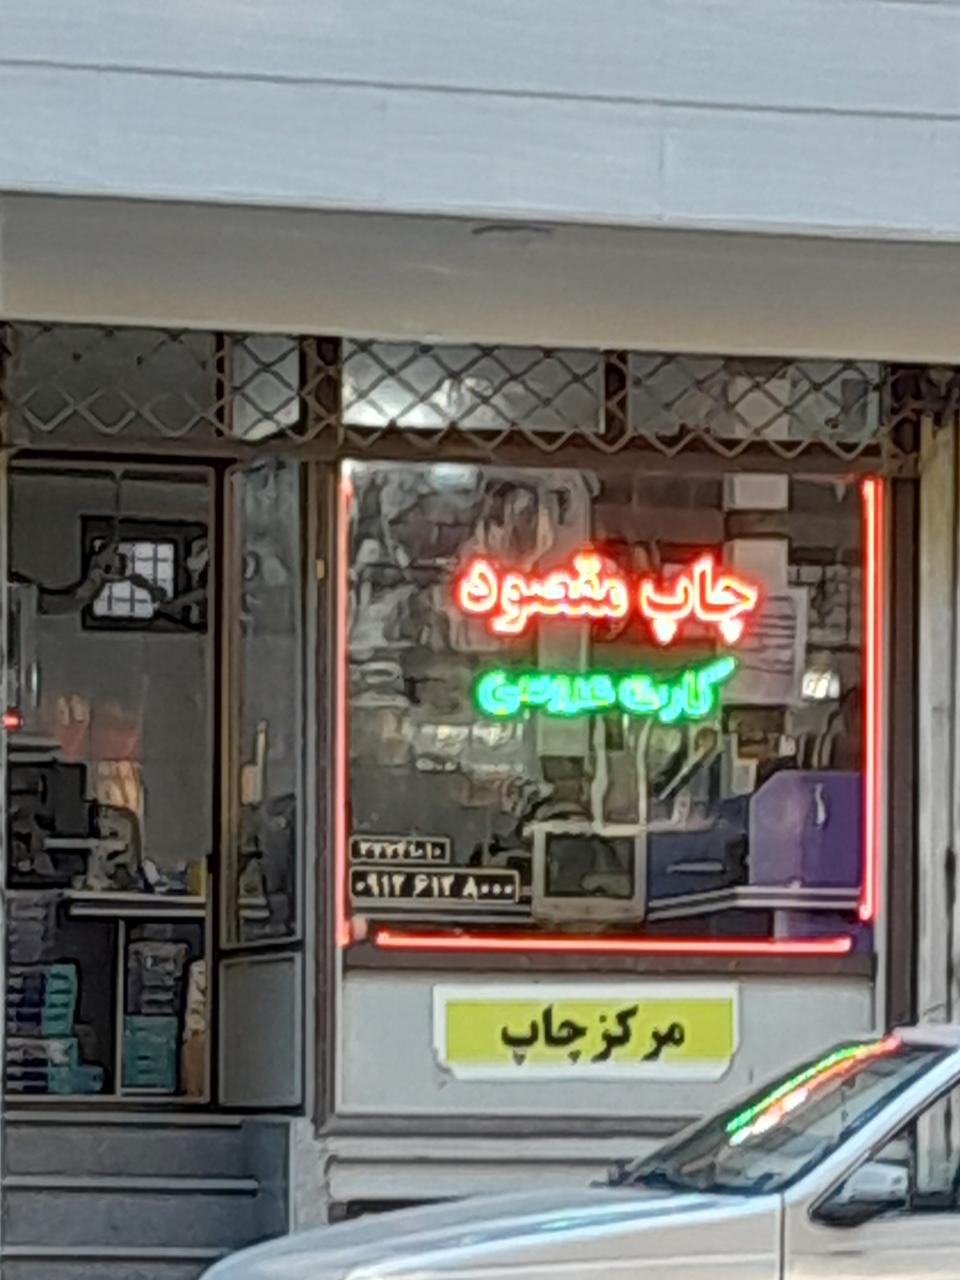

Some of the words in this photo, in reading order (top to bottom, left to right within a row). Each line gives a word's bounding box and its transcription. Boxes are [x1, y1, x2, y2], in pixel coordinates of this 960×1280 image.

[638, 554, 760, 644] چاپ
[474, 668, 616, 718] عروسی
[617, 655, 736, 723] کارت
[500, 1002, 589, 1065] چاپ
[590, 1003, 686, 1063] مرکز
